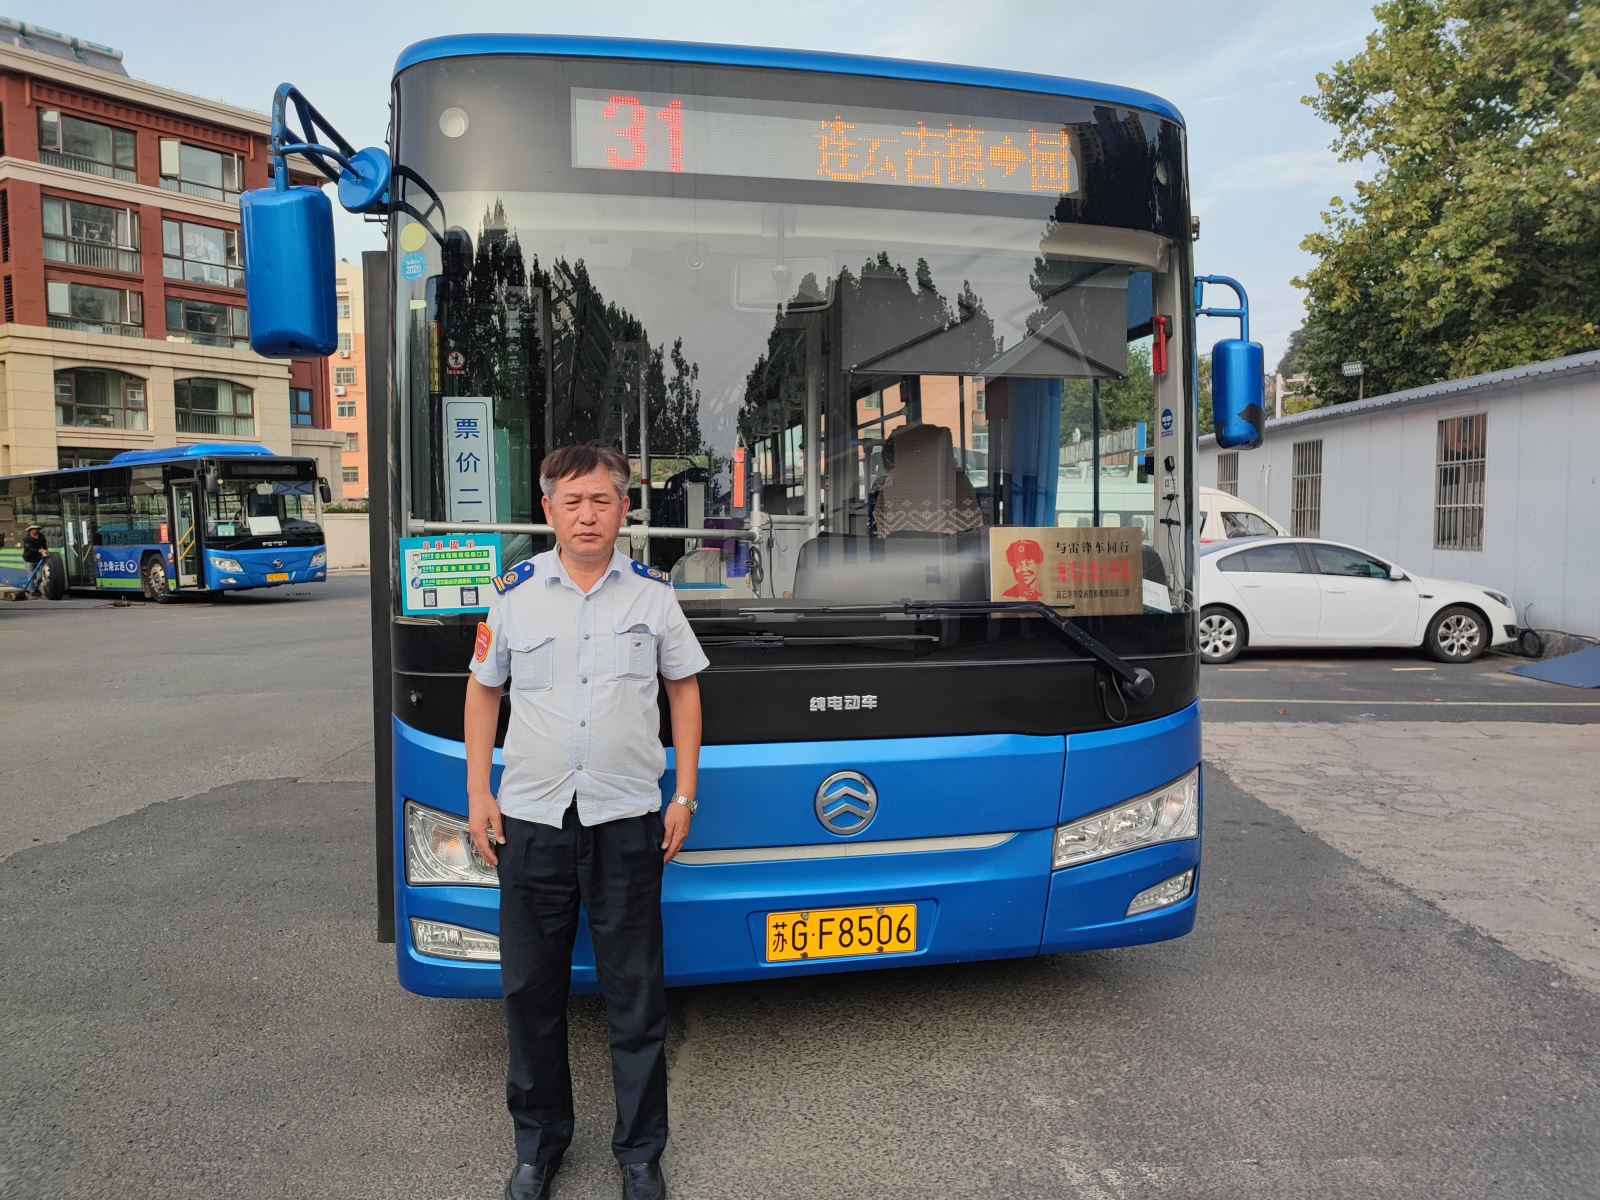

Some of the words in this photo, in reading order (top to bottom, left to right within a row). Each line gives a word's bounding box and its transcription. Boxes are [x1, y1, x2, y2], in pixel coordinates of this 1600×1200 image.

[603, 95, 684, 173] 31
[454, 418, 482, 522] 票价二
[1056, 541, 1130, 554] 与雷锋车同行
[809, 695, 878, 711] 纯电动车
